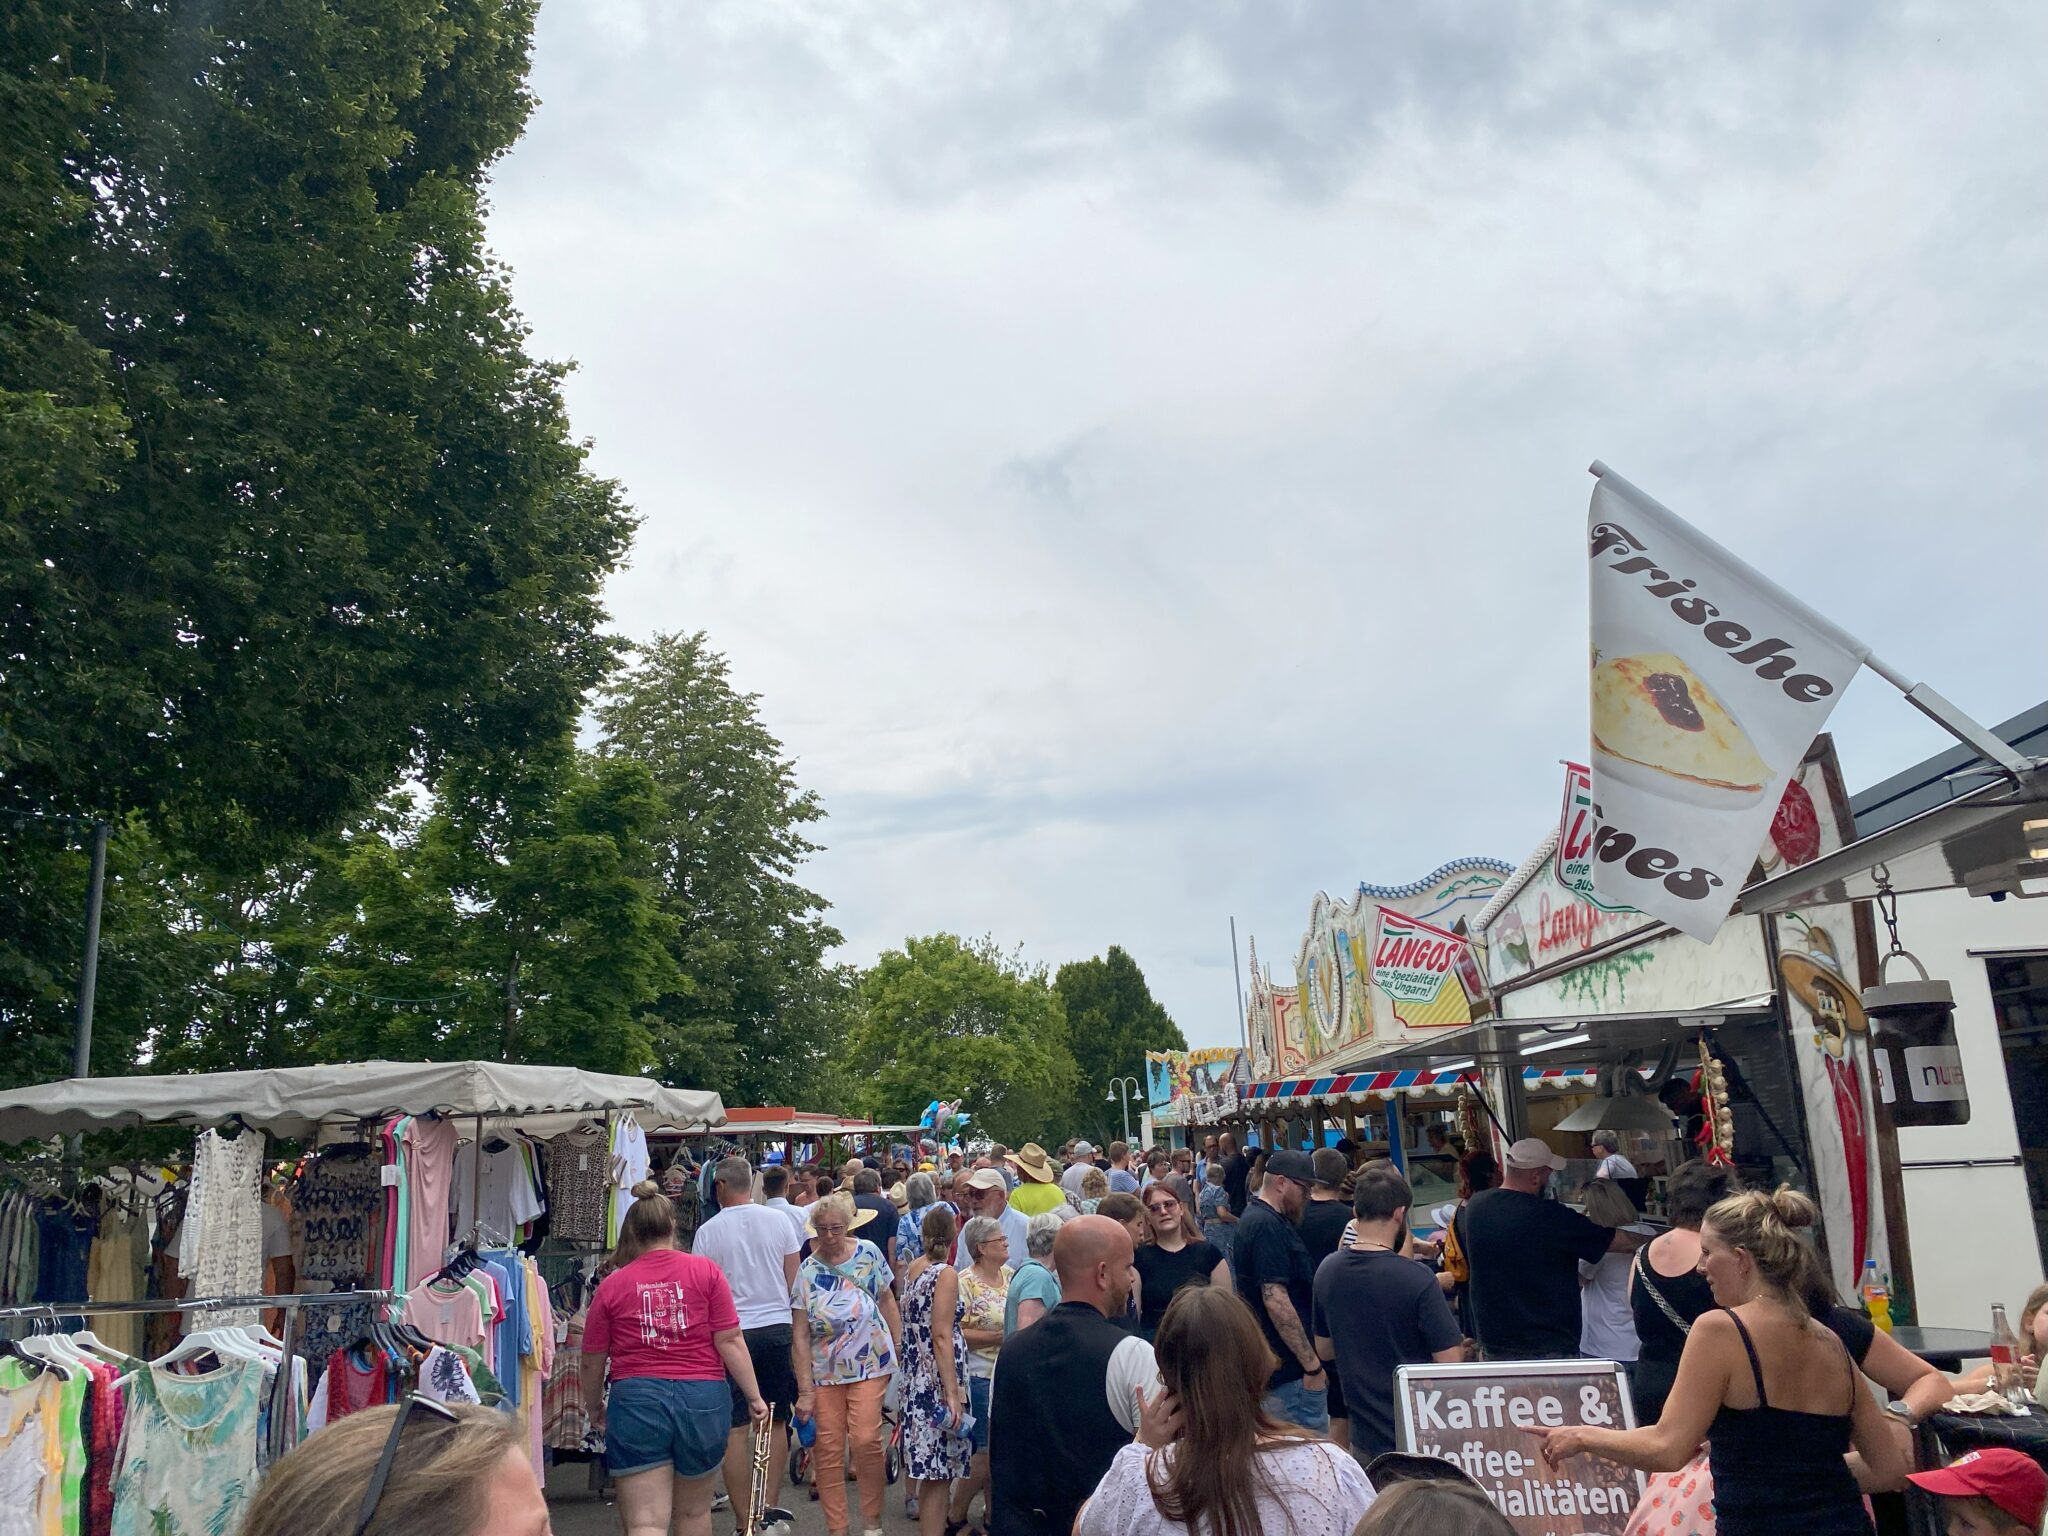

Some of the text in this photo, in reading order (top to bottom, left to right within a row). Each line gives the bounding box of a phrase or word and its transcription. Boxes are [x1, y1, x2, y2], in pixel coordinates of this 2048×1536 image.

[1590, 522, 1834, 703] Frische
[1565, 860, 1589, 875] eine
[1574, 878, 1594, 891] aus
[1375, 937, 1459, 973] LANGOS
[1375, 969, 1440, 987] eine Spezialität
[1380, 979, 1432, 998] aus Ungarn!
[1415, 1385, 1613, 1430] Kaffee &
[1487, 1478, 1630, 1517] ialitäten
